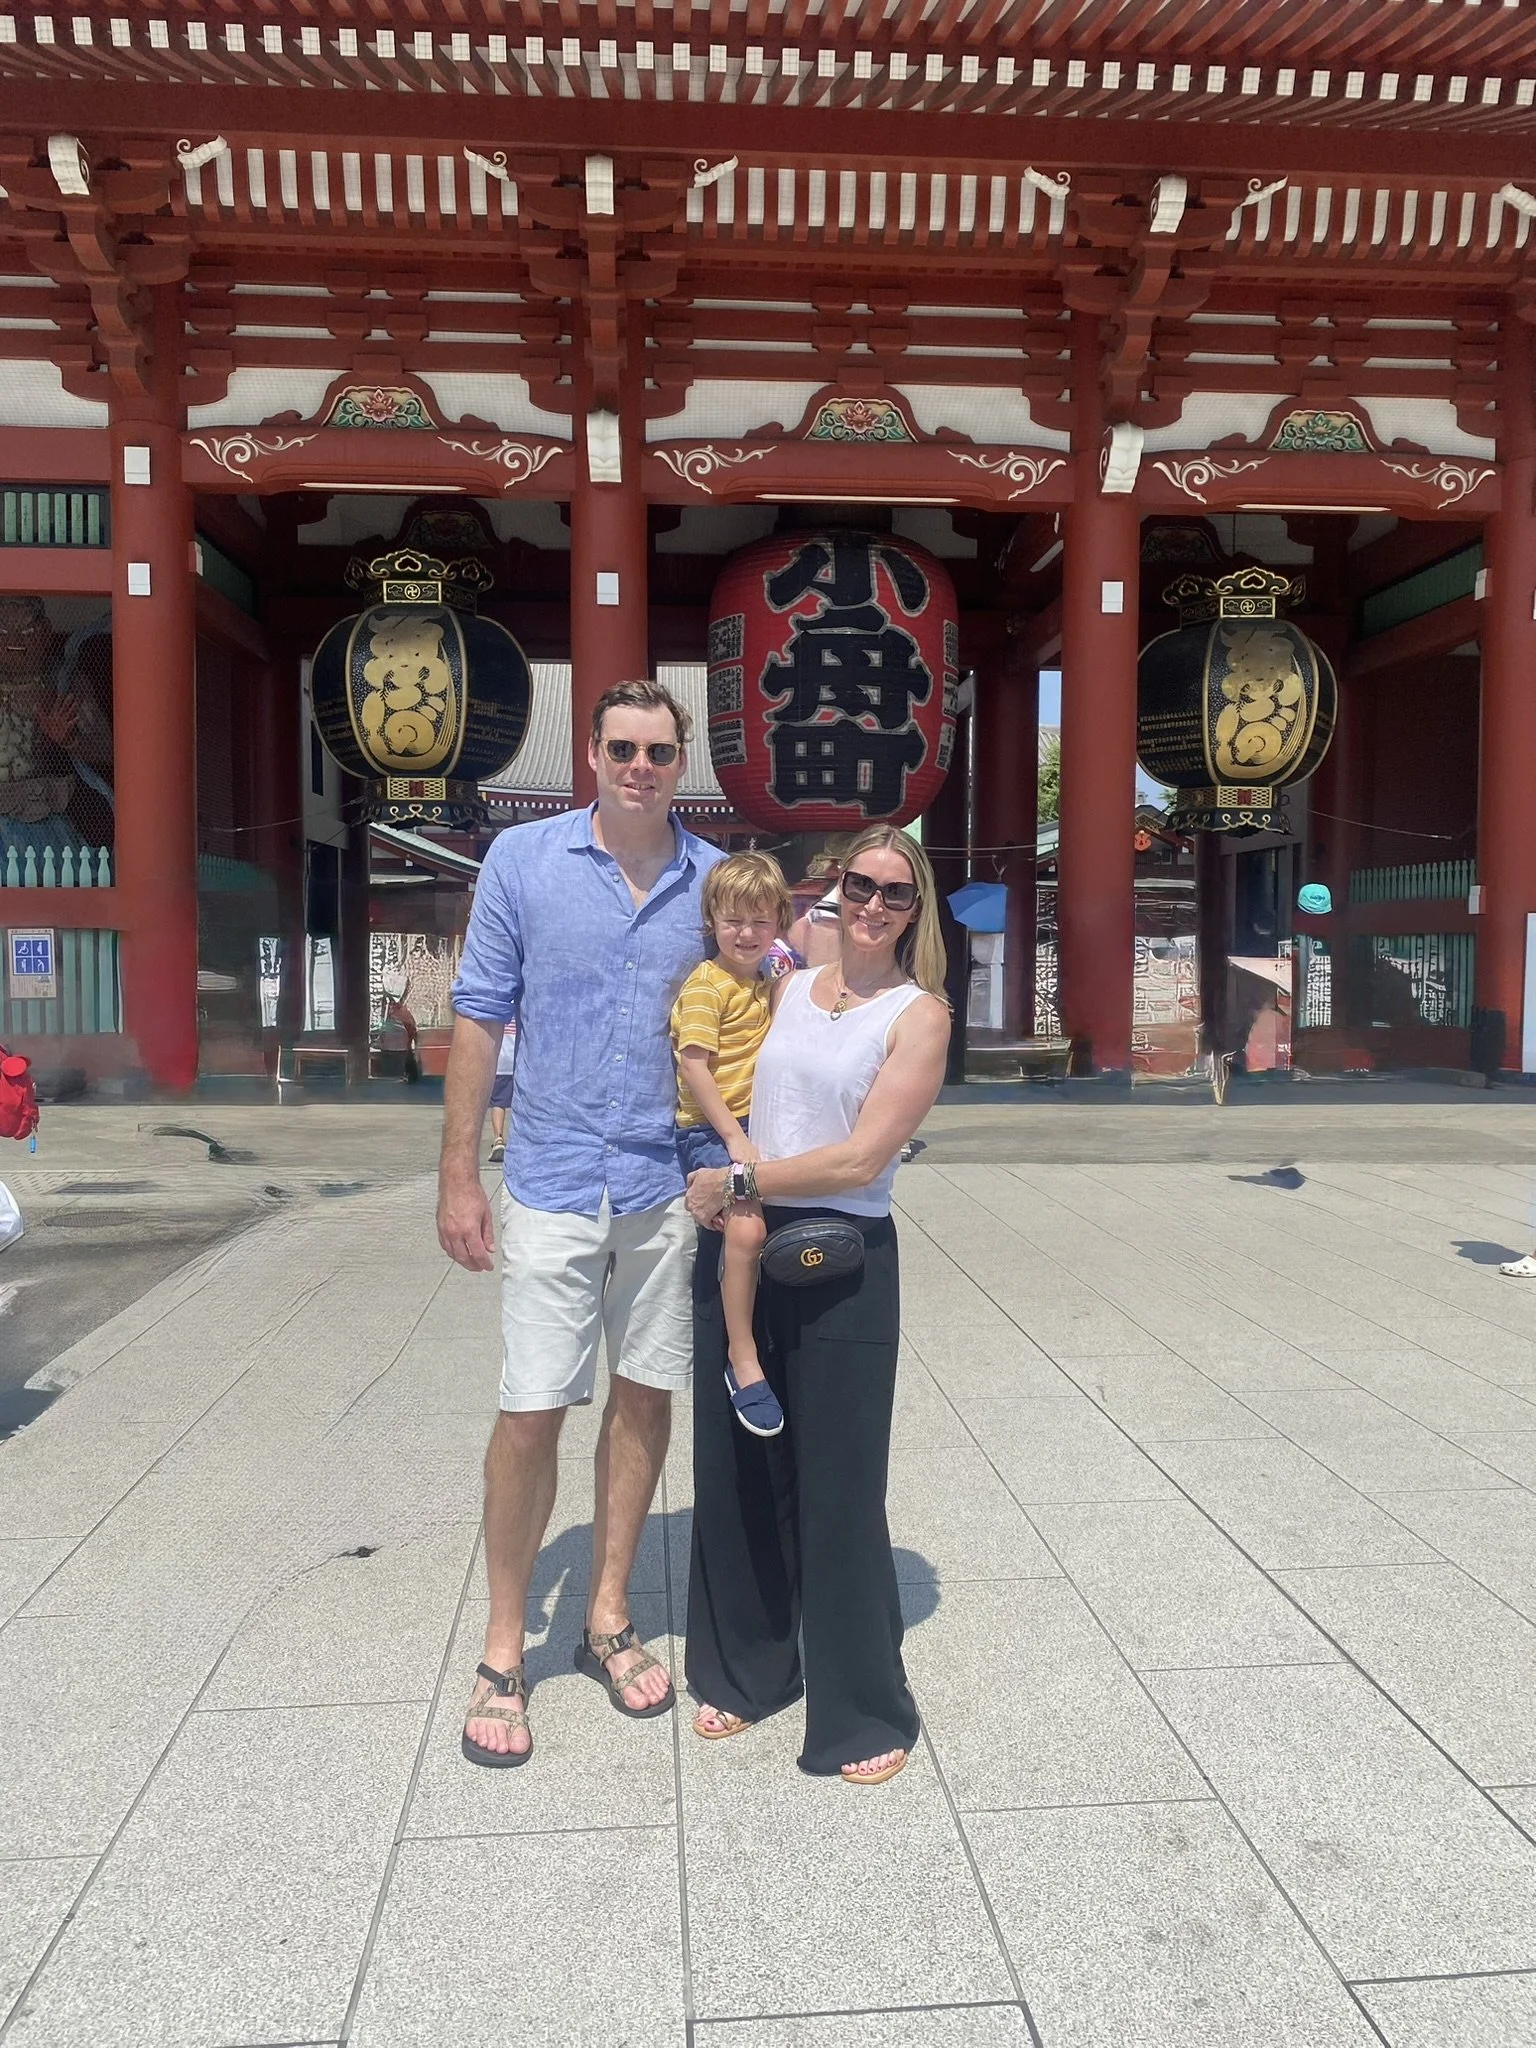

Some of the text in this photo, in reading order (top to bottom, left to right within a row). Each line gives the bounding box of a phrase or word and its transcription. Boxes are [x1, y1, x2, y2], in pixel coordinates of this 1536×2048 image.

[762, 541, 931, 817] 小舟町
[800, 1247, 823, 1267] GG
